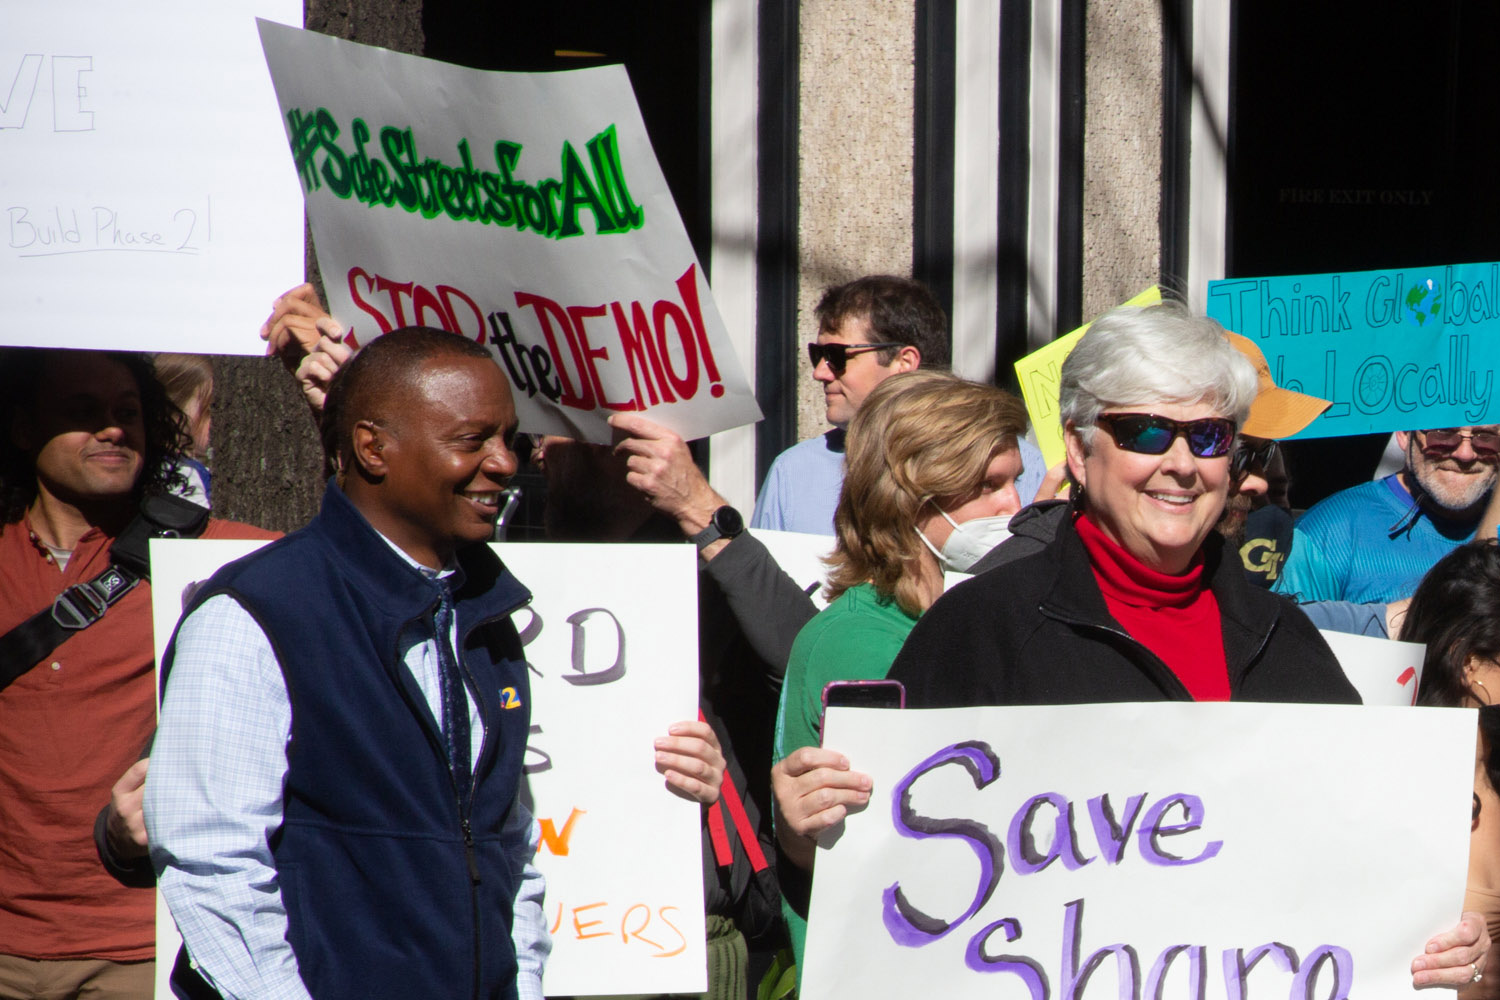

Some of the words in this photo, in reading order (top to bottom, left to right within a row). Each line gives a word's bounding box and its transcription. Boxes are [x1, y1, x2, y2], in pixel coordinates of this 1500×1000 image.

[6, 206, 82, 249] Build
[91, 206, 166, 246] Phase
[1279, 188, 1325, 204] FIRE
[1328, 189, 1377, 205] EXIT
[1380, 189, 1434, 207] ONLY
[514, 262, 726, 412] DEMO!
[1211, 275, 1352, 338] Think
[488, 311, 562, 404] the
[882, 740, 1223, 948] Save
